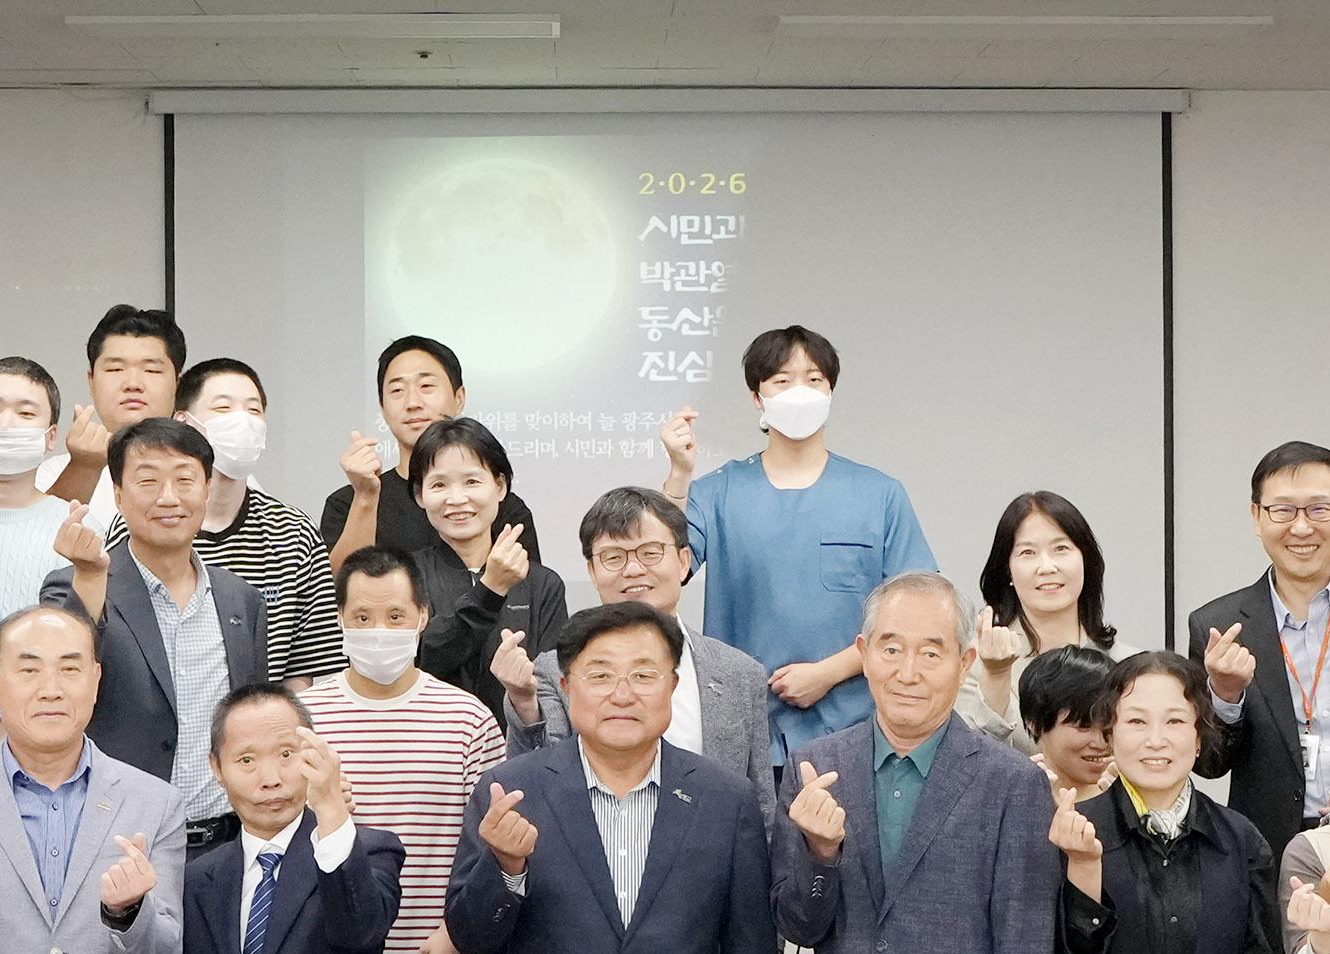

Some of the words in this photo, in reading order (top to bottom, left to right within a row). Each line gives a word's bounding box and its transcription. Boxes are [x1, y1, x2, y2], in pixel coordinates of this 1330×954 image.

[525, 411, 592, 432] 맞이하여
[598, 411, 616, 432] 늘
[564, 437, 615, 460] 시민과
[619, 437, 655, 460] 함께
